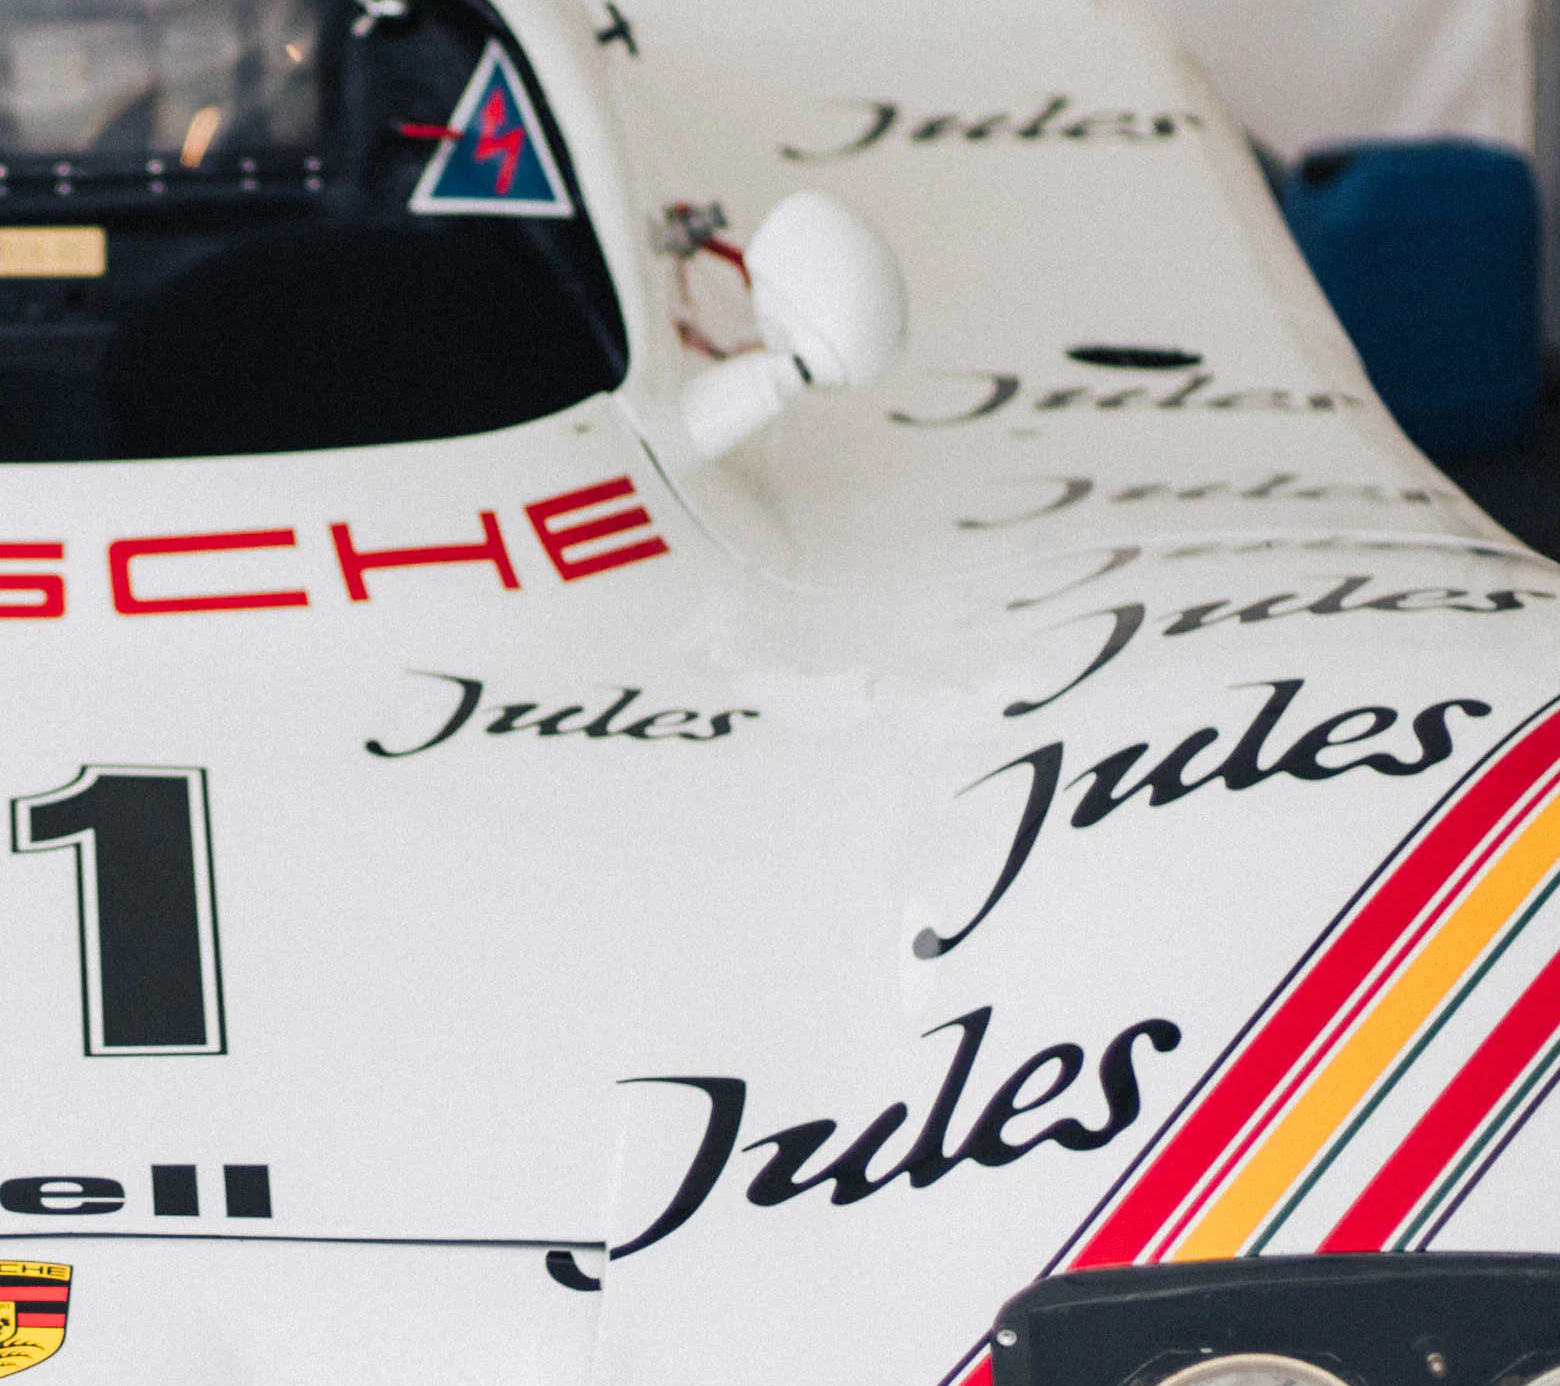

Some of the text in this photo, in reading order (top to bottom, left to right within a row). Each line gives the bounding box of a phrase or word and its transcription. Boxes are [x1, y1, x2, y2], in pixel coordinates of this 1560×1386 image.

[779, 96, 1203, 163] Jules
[363, 671, 762, 759] Jules
[1002, 575, 1557, 718] Jules
[912, 678, 1493, 962] Jules
[545, 1004, 1182, 1292] Jules
